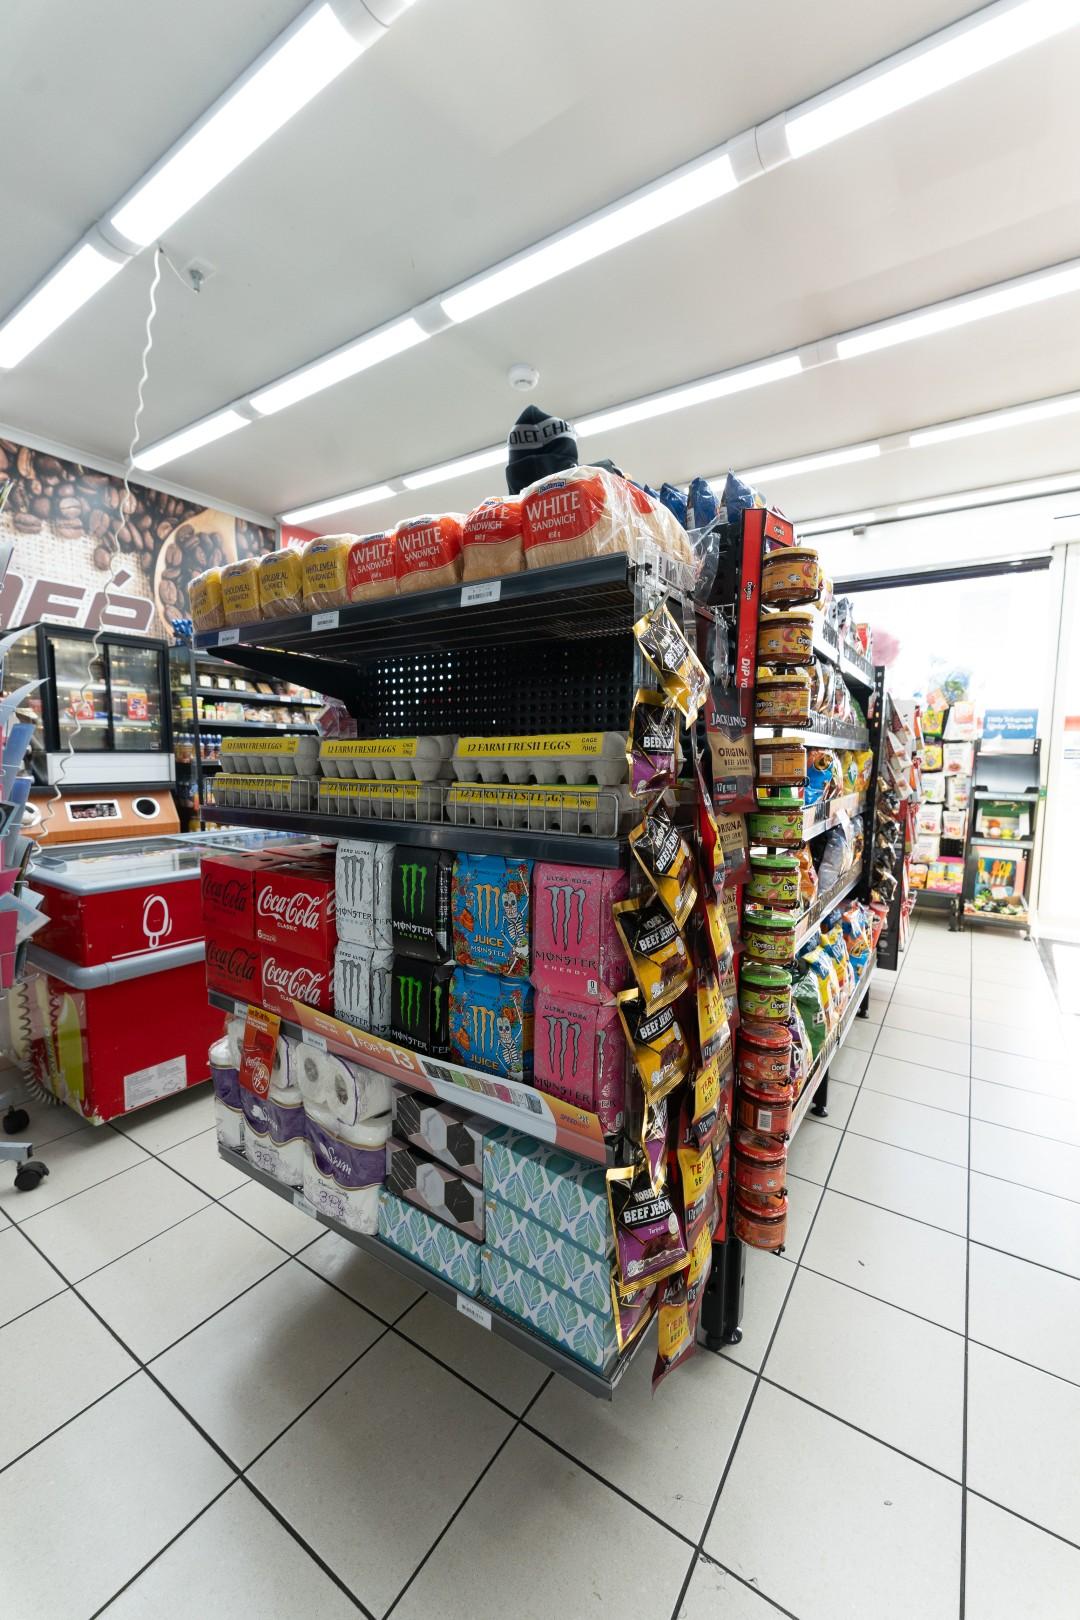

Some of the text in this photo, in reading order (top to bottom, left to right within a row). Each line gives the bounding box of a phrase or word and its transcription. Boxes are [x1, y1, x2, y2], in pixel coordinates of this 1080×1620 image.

[526, 491, 580, 521] WHITE
[464, 521, 502, 533] SANDWICH
[532, 513, 576, 532] SANDWICH
[399, 527, 444, 552] WHITE
[405, 546, 440, 562] SANDWICH
[357, 558, 392, 573] SANDWICH
[377, 745, 396, 753] EGGS
[478, 743, 505, 751] FARM
[506, 742, 541, 751] FRESH
[543, 741, 571, 750] EGGS
[655, 848, 668, 872] BEEF
[336, 906, 373, 921] MONSTER
[277, 922, 298, 932] CLASSIC
[393, 920, 434, 936] MONSTER
[473, 935, 505, 948] JUICE
[638, 934, 660, 952] BEEF
[470, 945, 509, 959] MONSTER
[535, 951, 597, 970] MONSTER
[544, 964, 587, 977] ENERGY
[640, 1019, 658, 1040] BEEF
[345, 1030, 359, 1048] 1
[391, 1029, 428, 1051] MONSTER
[472, 1054, 499, 1070] JUICE
[535, 1075, 591, 1105] MONSTER
[623, 1206, 649, 1224] BEEF
